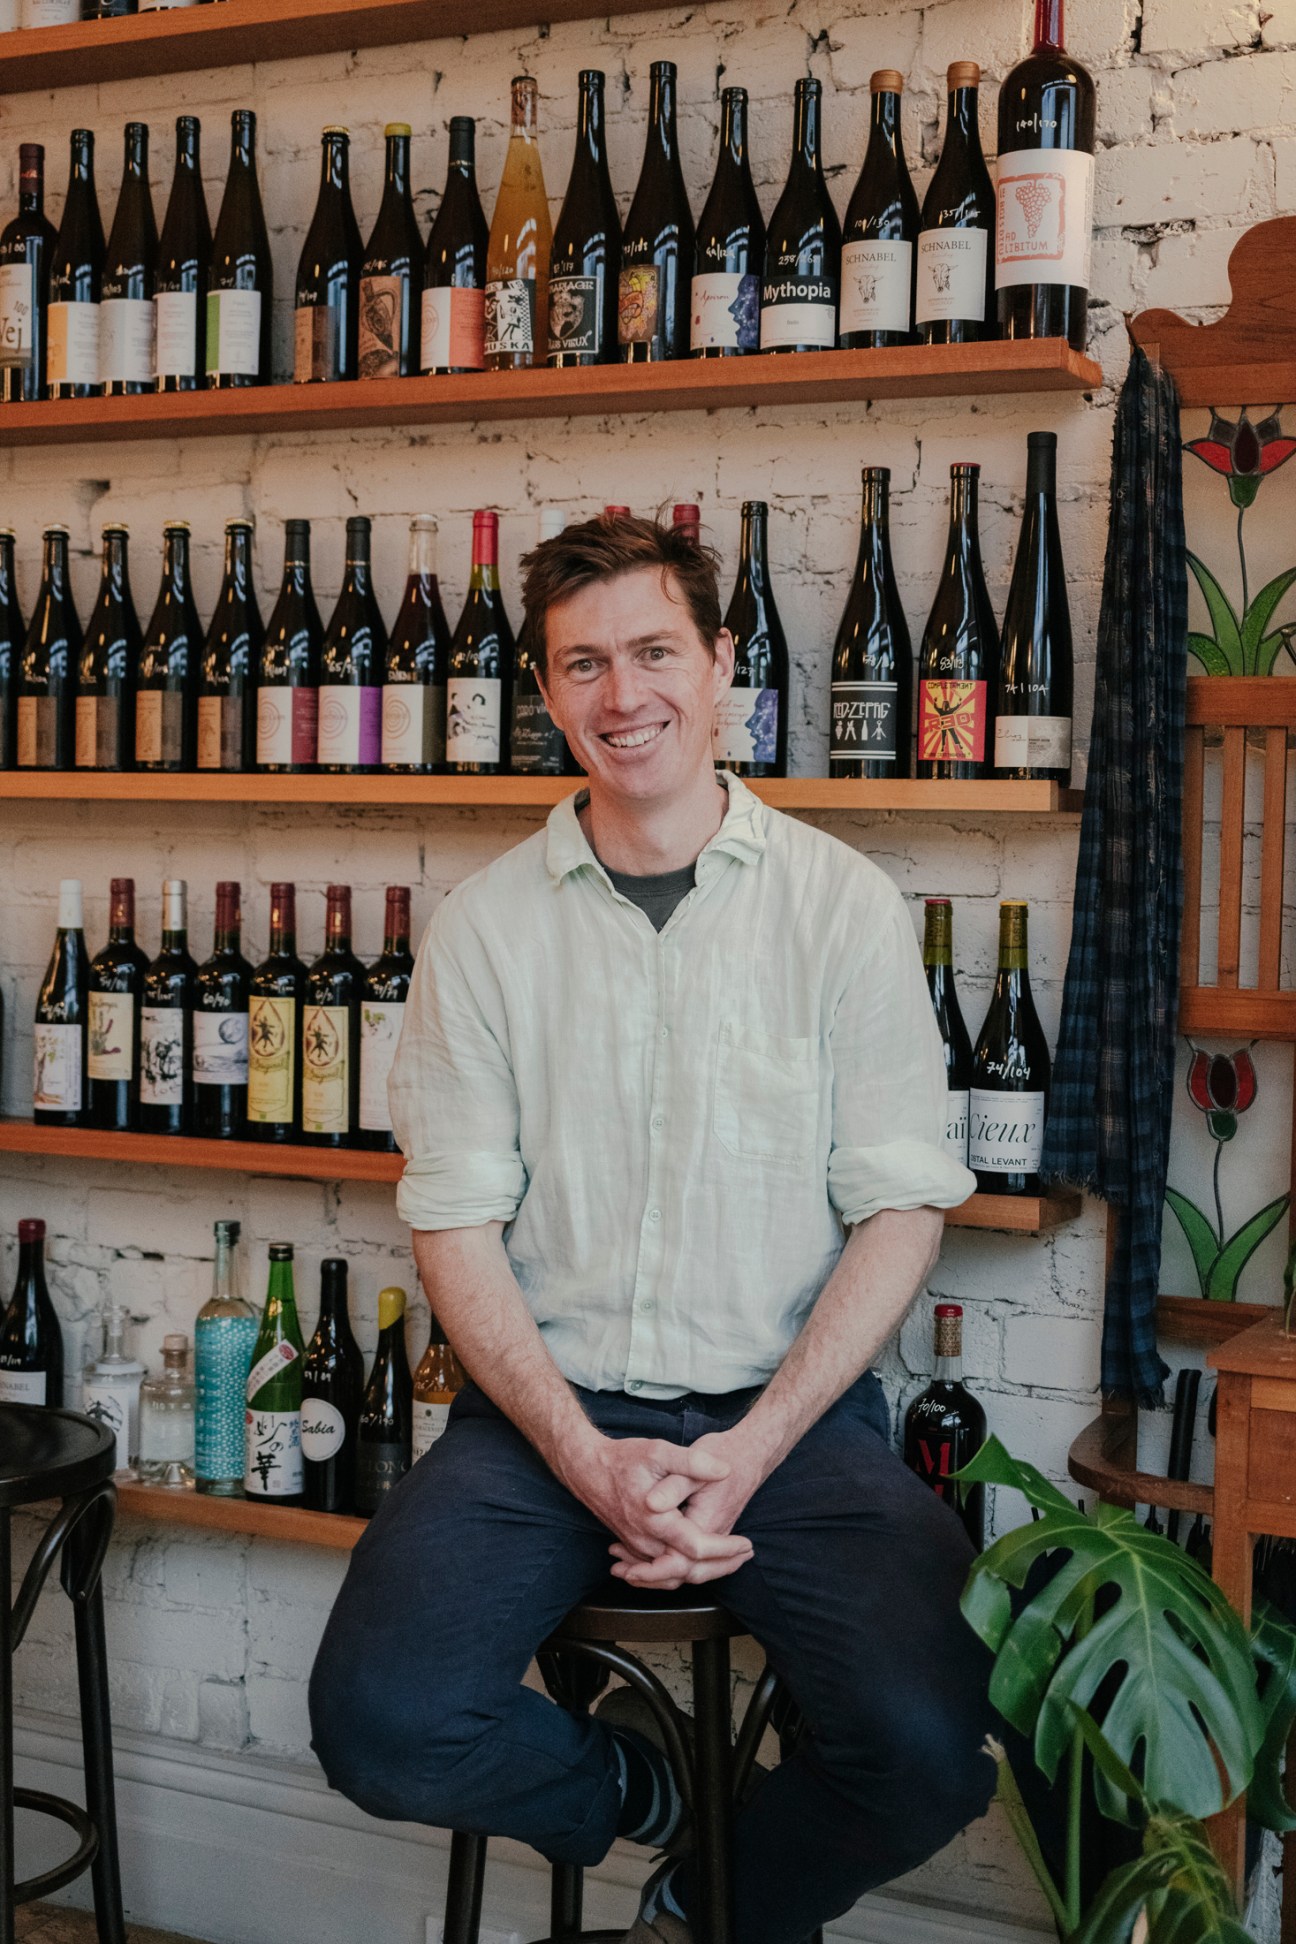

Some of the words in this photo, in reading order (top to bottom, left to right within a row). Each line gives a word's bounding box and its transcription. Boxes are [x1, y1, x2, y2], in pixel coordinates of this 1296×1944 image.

[1005, 232, 1016, 241] AD
[921, 240, 972, 254] SCHNABEL
[1005, 240, 1049, 254] LIBITUM
[845, 252, 897, 265] SCHNABEL
[763, 281, 831, 302] Mythopia
[986, 1061, 1031, 1080] 74/104
[992, 1158, 1027, 1167] LEVANT
[302, 1420, 335, 1435] Sabia
